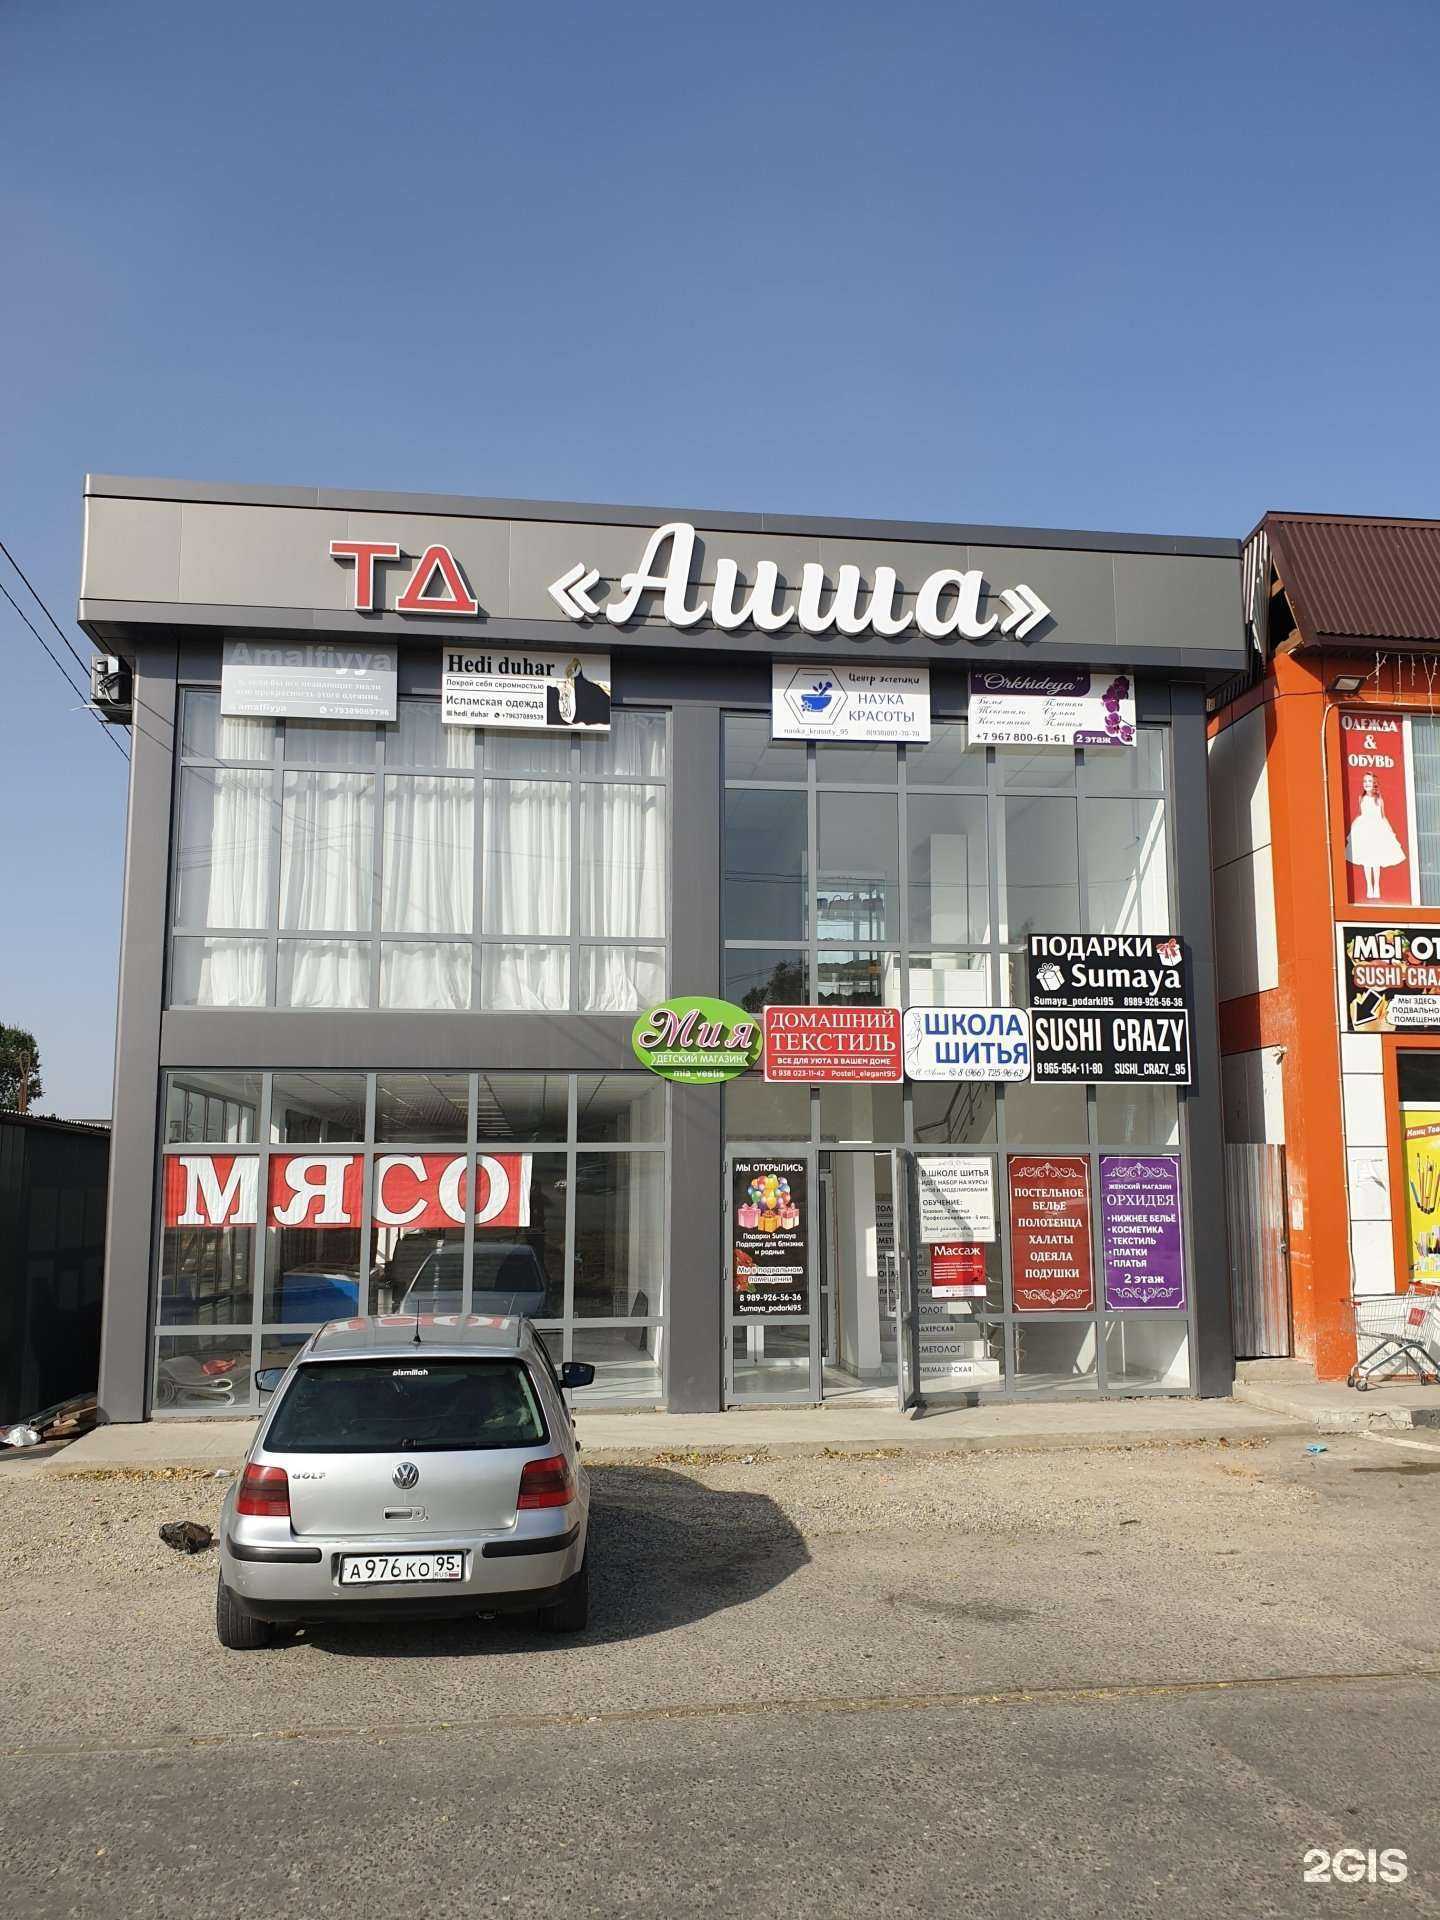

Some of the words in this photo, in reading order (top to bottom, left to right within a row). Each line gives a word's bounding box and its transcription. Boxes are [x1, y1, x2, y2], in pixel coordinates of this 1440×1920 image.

[329, 539, 479, 617] ТД
[230, 642, 392, 676] Amalfiyya
[447, 654, 493, 673] Hedi
[498, 656, 555, 677] duhar
[446, 678, 474, 688] Покрой
[476, 680, 493, 688] себя
[495, 682, 545, 690] скромностью
[848, 673, 876, 686] Центр
[880, 676, 920, 686] эстетики
[446, 695, 503, 707] Исламская
[505, 699, 545, 710] одежда
[858, 693, 905, 705] НАУКА
[849, 710, 915, 722] КРАСОТЫ
[975, 732, 989, 741] +7
[991, 733, 1011, 742] 967
[1013, 733, 1066, 743] 800-61-61
[1076, 735, 1083, 743] 2
[1084, 736, 1111, 744] этаж
[1364, 734, 1377, 749] &
[1348, 754, 1395, 768] ОБУВЬ
[1032, 936, 1152, 961] ПОДАРКИ
[1353, 935, 1402, 959] МЫ
[1071, 963, 1181, 996] Sumaya
[1355, 967, 1400, 986] SUSHI
[1407, 968, 1440, 986] CRA
[1034, 996, 1114, 1007] Sumaya_podarki95
[1398, 997, 1411, 1005] МЫ
[1414, 997, 1437, 1005] ЗДЕСЬ
[770, 1010, 896, 1030] ДОМАШНИЙ
[925, 1013, 1023, 1036] ШКОЛА
[638, 1008, 754, 1048] Мия
[1035, 1018, 1102, 1051] SUSHI
[1113, 1018, 1184, 1052] CRAZY
[770, 1033, 896, 1051] ТЕКСТИЛЬ
[657, 1053, 698, 1063] ДЕТСКИЙ
[700, 1054, 743, 1063] МАГАЗИН
[935, 1042, 1028, 1064] ШИТЬЯ
[869, 1058, 891, 1066] ДОМЕ
[1037, 1063, 1042, 1074] 8
[1044, 1063, 1102, 1074] 965-954-11-80
[1115, 1063, 1185, 1076] SUSHI_CRAZY_95
[736, 1164, 750, 1172] МЫ
[753, 1163, 804, 1172] ОТКРЫЛИСЬ
[921, 1169, 927, 1177] В
[928, 1169, 958, 1177] ШКОЛЕ
[960, 1169, 989, 1177] ШИТЬЯ
[177, 1154, 511, 1226] МЯСО
[1014, 1188, 1084, 1198] ПОСТЕЛЬНОЕ
[1107, 1194, 1175, 1207] ОРХИДЕЯ
[1018, 1218, 1082, 1229] ПОЛОТЕНЦА
[1111, 1215, 1148, 1223] НИЖНЕЕ
[1112, 1226, 1164, 1234] КОСМЕТИКА
[1029, 1235, 1073, 1244] ХАЛАТЫ
[1113, 1237, 1157, 1245] ТЕКСТИЛЬ
[934, 1245, 981, 1256] Массаж
[1030, 1252, 1073, 1263] ОДЕЯЛА
[737, 1266, 751, 1274] Мы
[758, 1266, 803, 1275] подвальном
[1025, 1268, 1079, 1280] ПОДУШКИ
[748, 1275, 793, 1284] помещении
[1124, 1274, 1132, 1283] 2
[1134, 1275, 1164, 1284] этаж
[739, 1304, 802, 1312] Sumaya_podarki95
[436, 1556, 455, 1571] 95
